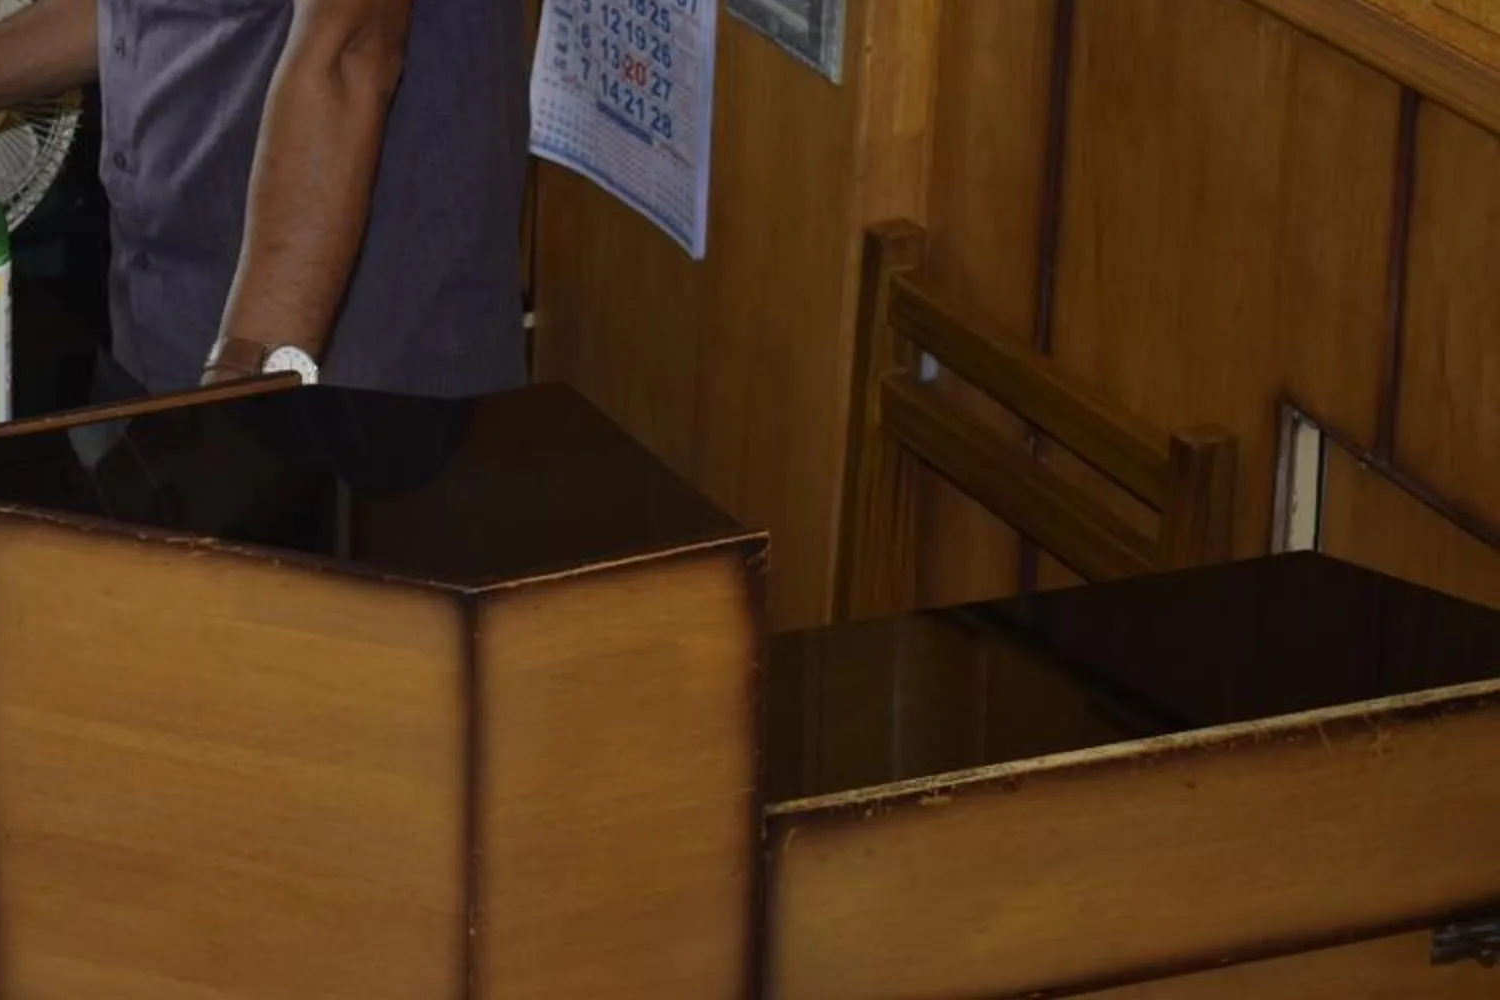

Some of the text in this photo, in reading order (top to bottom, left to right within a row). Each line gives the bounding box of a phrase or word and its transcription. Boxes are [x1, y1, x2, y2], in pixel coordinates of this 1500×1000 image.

[601, 3, 622, 36] 12
[626, 19, 647, 51] 19
[650, 35, 672, 70] 26
[650, 0, 671, 34] 25
[580, 23, 592, 49] 6
[601, 37, 620, 70] 13
[622, 53, 647, 88] 20
[650, 72, 673, 103] 27
[581, 56, 592, 82] 7
[601, 72, 620, 105] 14
[625, 88, 645, 120] 21
[650, 106, 673, 140] 28
